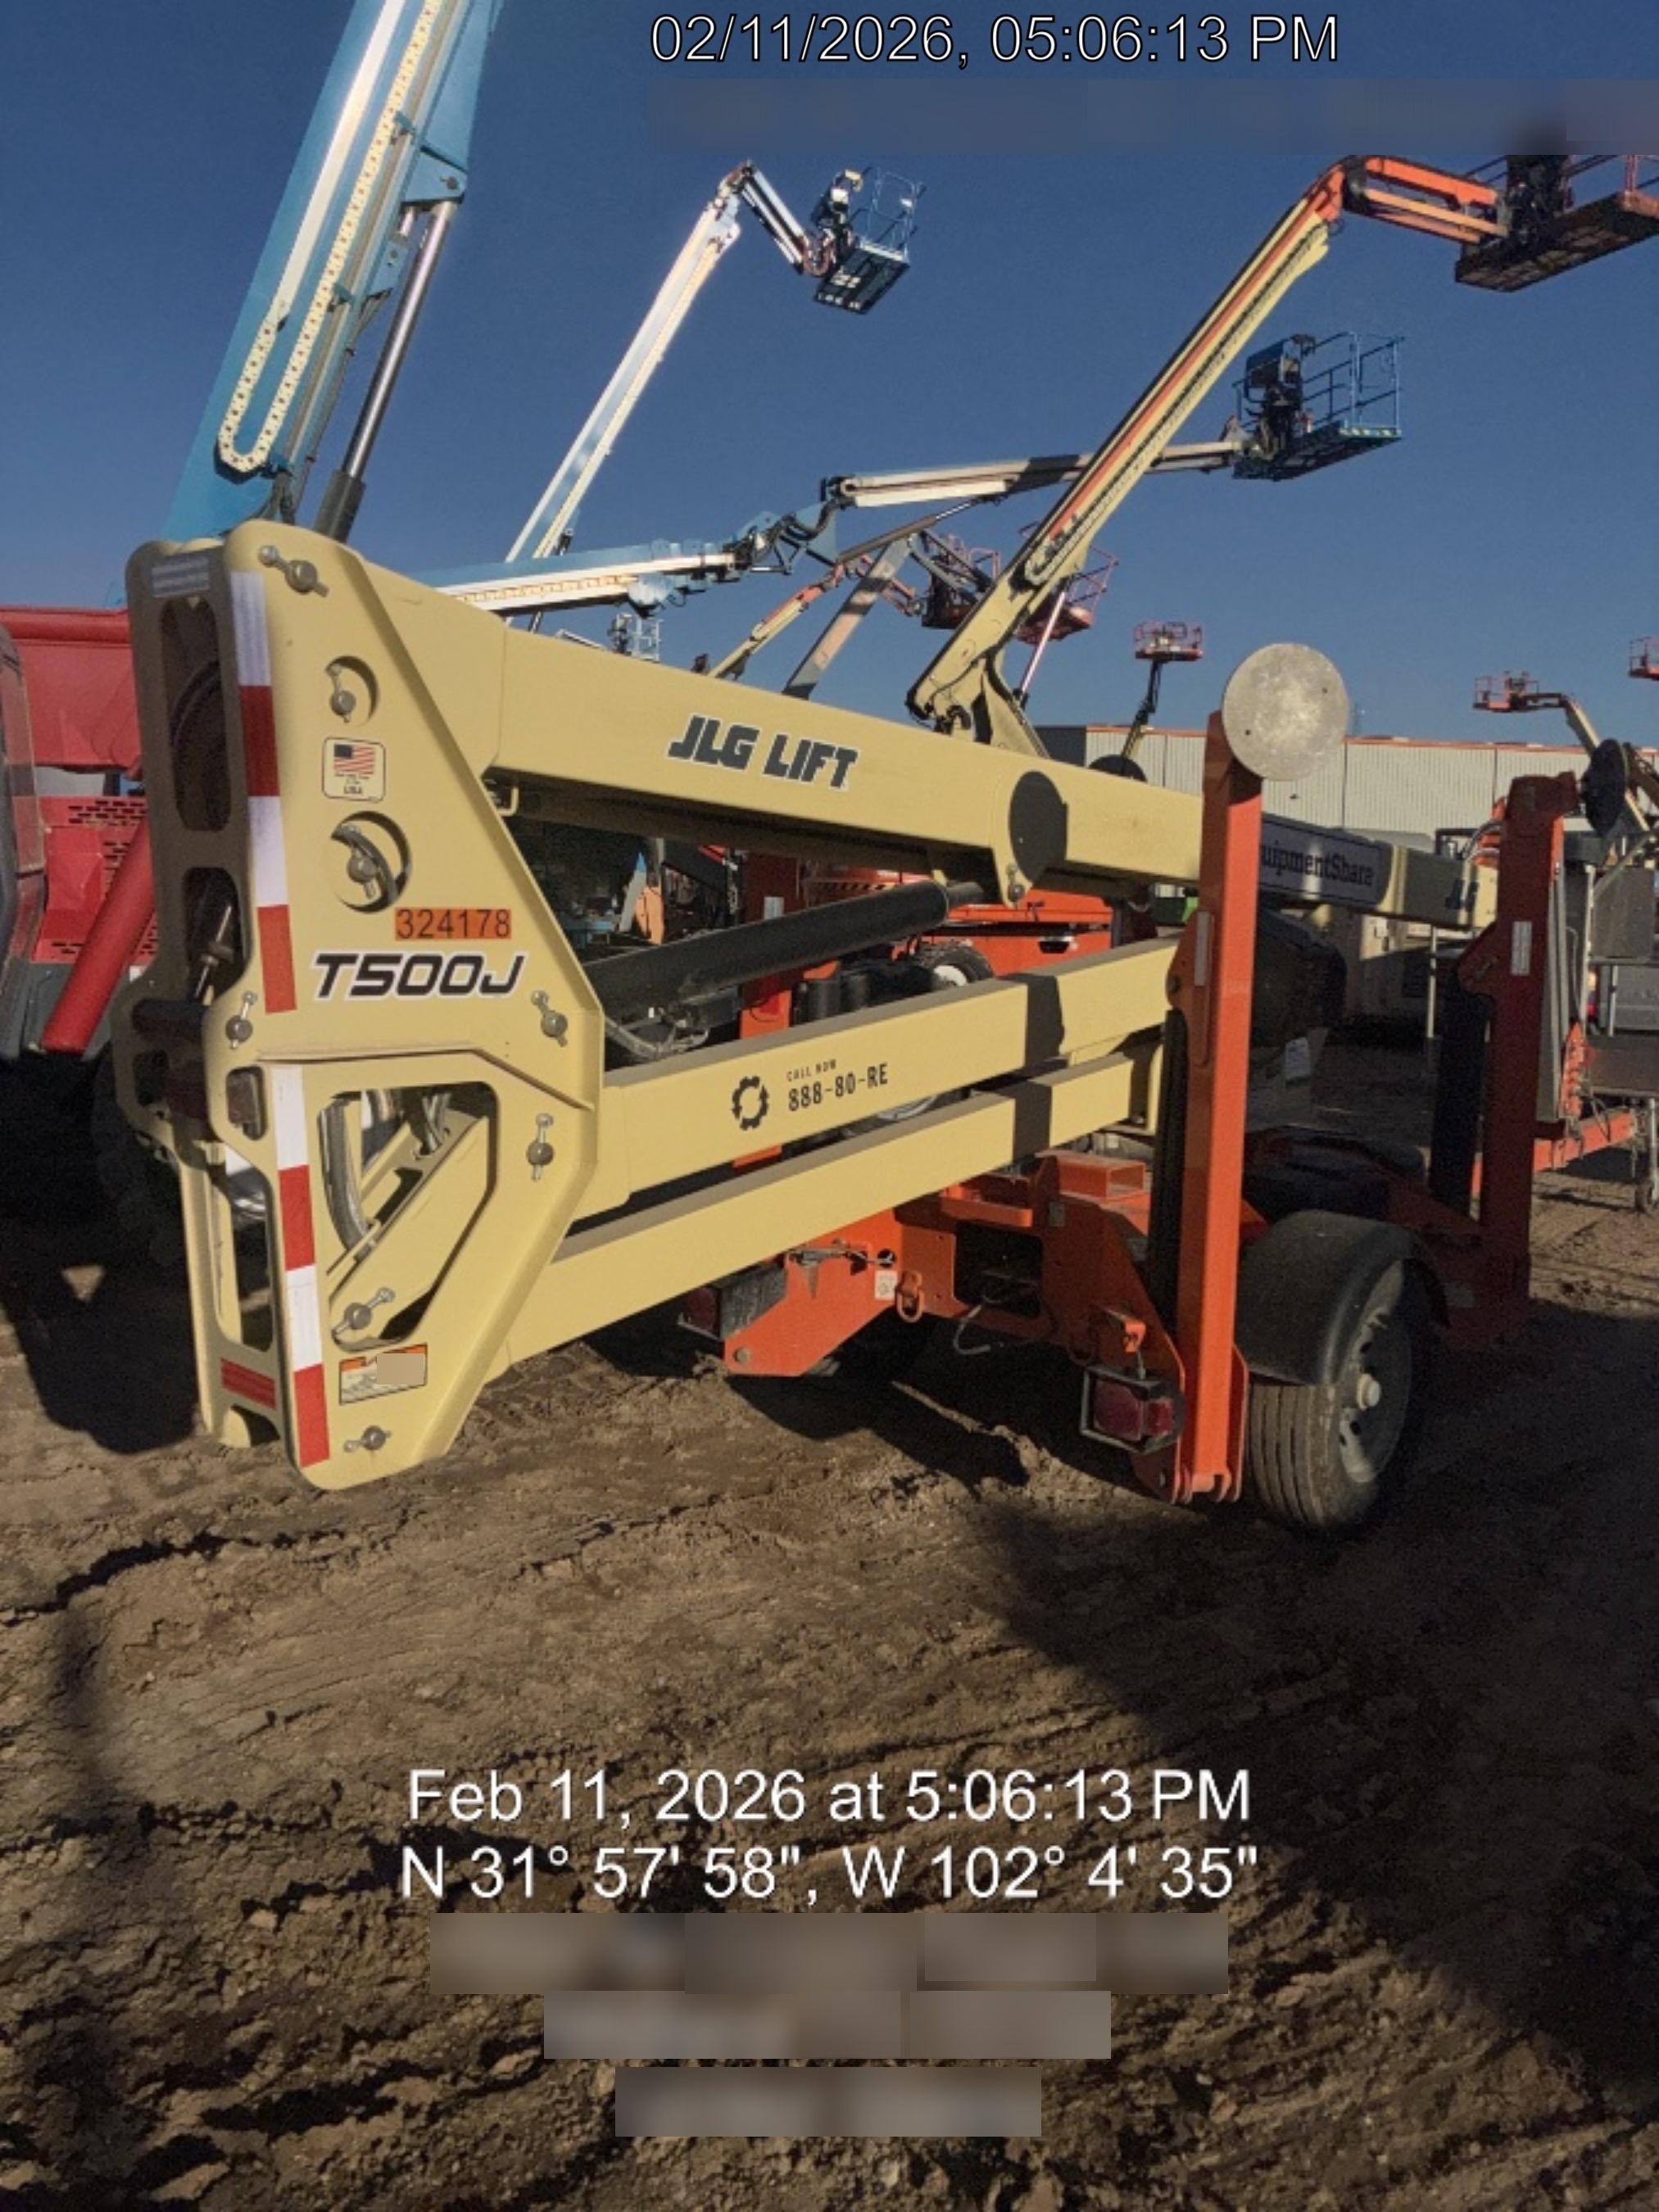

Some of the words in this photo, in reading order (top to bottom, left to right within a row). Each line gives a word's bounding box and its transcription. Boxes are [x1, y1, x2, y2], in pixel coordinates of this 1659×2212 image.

[668, 714, 760, 770] JLG
[763, 733, 859, 789] LIFT
[1261, 839, 1374, 886] uipmentShare
[397, 908, 510, 939] 324178
[315, 953, 525, 998] T500J
[786, 1066, 812, 1082] CALL
[815, 1058, 836, 1074] NOW
[788, 1063, 888, 1112] 888-80-RE
